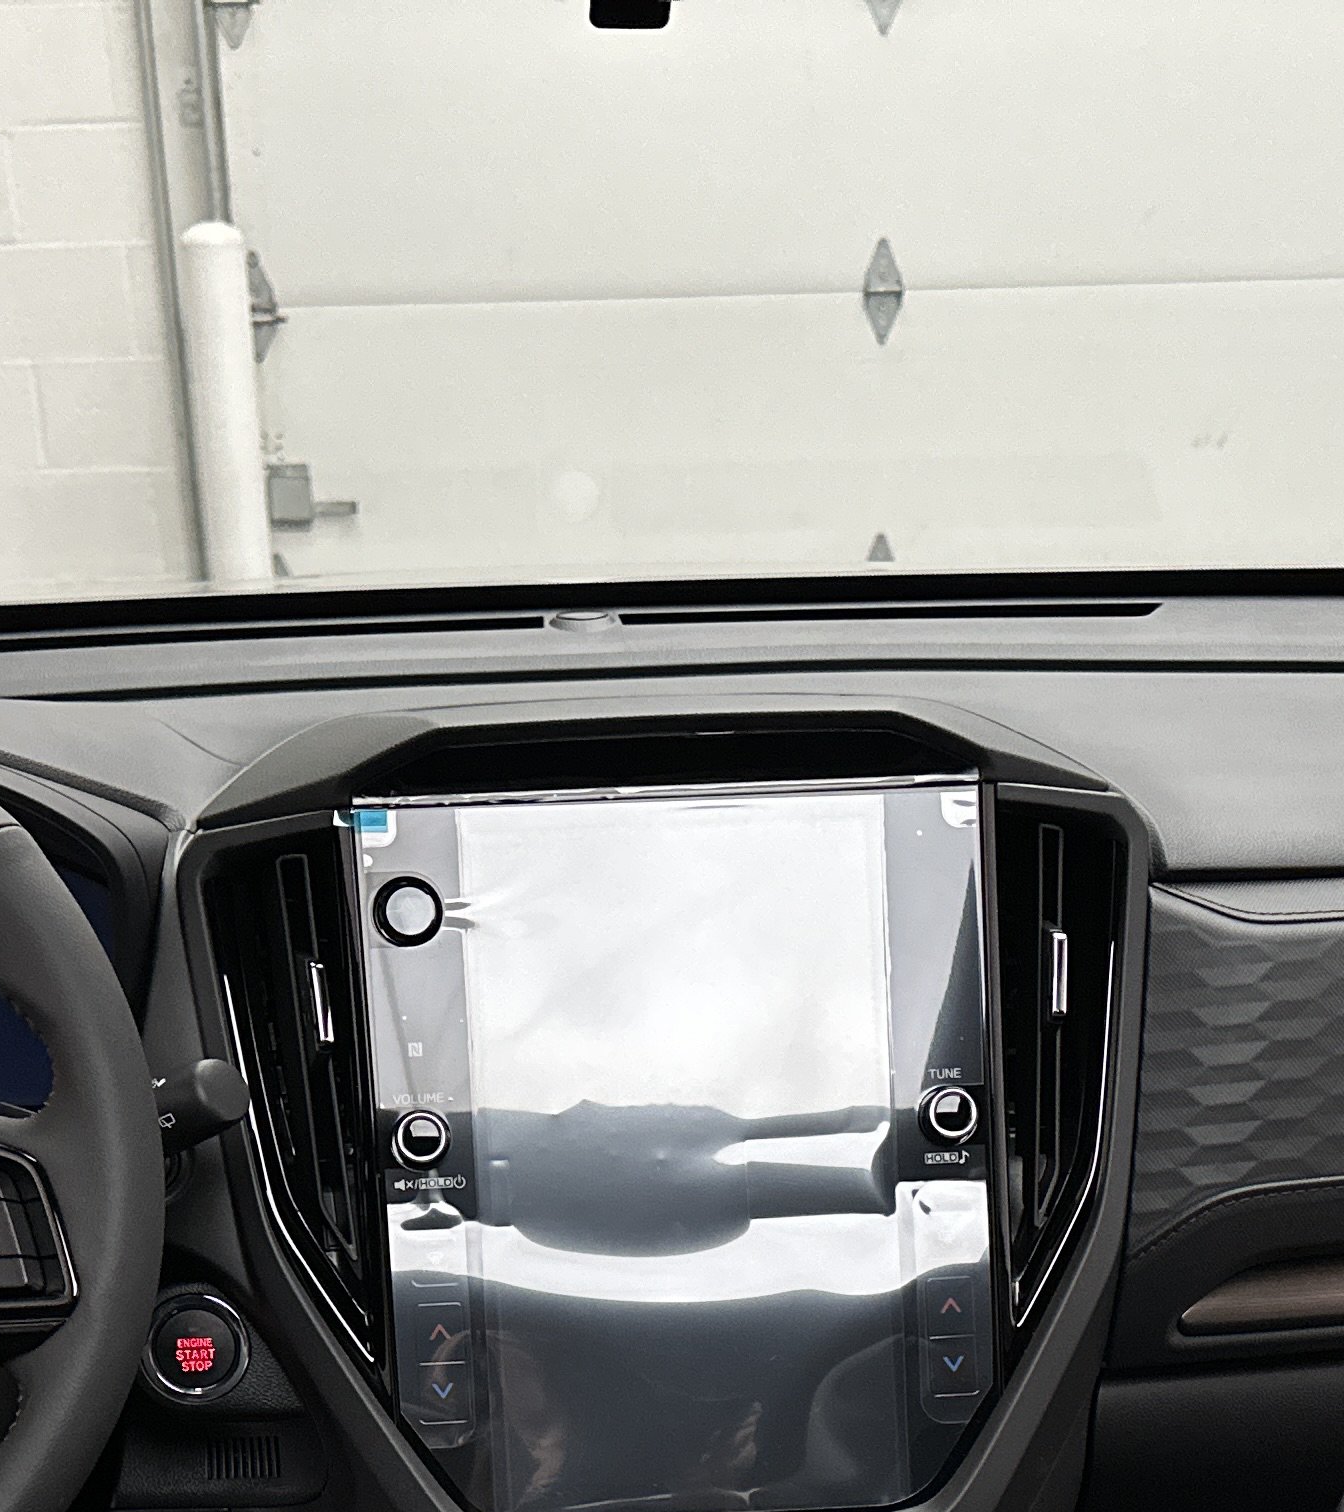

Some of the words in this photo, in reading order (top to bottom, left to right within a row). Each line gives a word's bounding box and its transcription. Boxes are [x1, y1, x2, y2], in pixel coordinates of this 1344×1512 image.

[928, 1067, 962, 1080] TUNE
[392, 1092, 445, 1105] VOLUME
[925, 1152, 958, 1164] HOLD
[419, 1178, 452, 1190] HOLD
[176, 1337, 213, 1348] ENGINE
[175, 1348, 216, 1361] START
[181, 1360, 213, 1372] STOP
